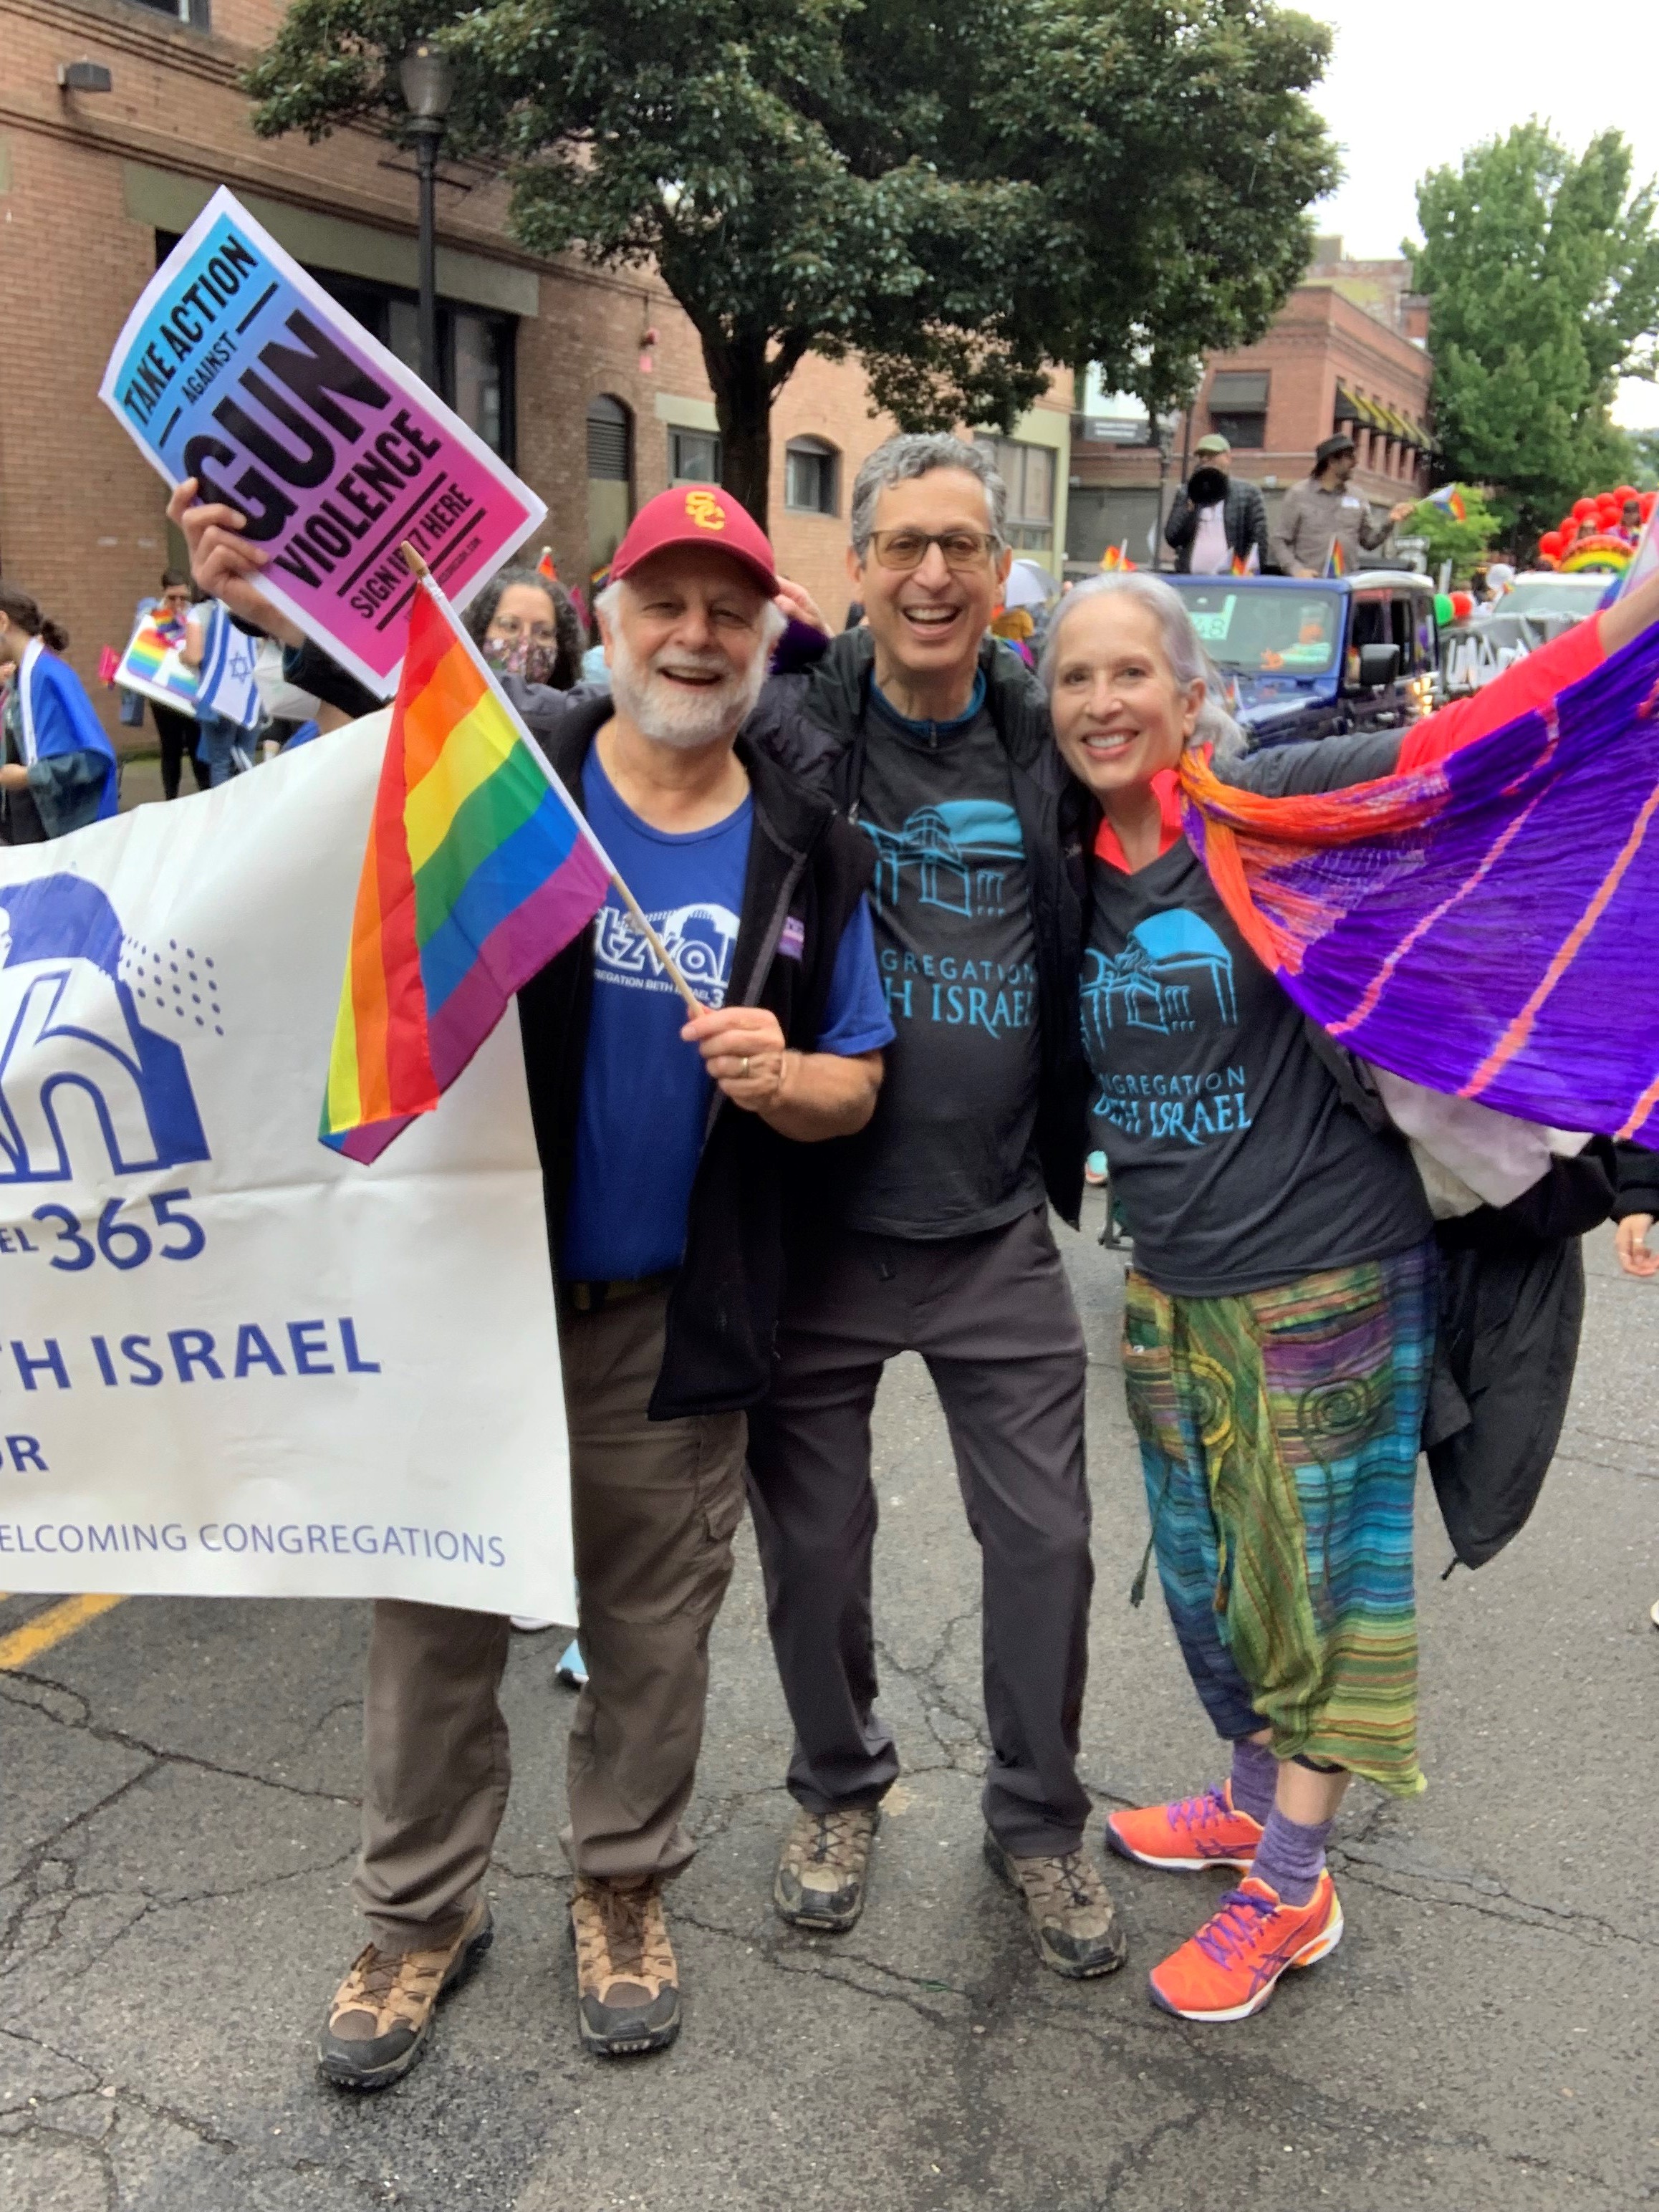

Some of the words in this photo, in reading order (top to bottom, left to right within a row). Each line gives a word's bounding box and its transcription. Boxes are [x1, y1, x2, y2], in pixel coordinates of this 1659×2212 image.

[125, 342, 177, 425] TAKE
[159, 234, 258, 363] ACTION
[181, 331, 239, 405] AGAINST
[184, 309, 392, 542] GUN
[273, 408, 442, 589] VIOLENCE
[685, 491, 726, 531] SC
[350, 564, 402, 619] SIGN
[419, 482, 473, 539] HERE
[881, 948, 1037, 986] GREGATION
[1150, 1092, 1252, 1146] ISRAEL
[32, 1186, 206, 1272] 365
[0, 1337, 72, 1390] H
[90, 1317, 381, 1387] ISRAEL
[0, 1434, 49, 1472] R
[198, 1523, 507, 1567] CONGREGATIONS
